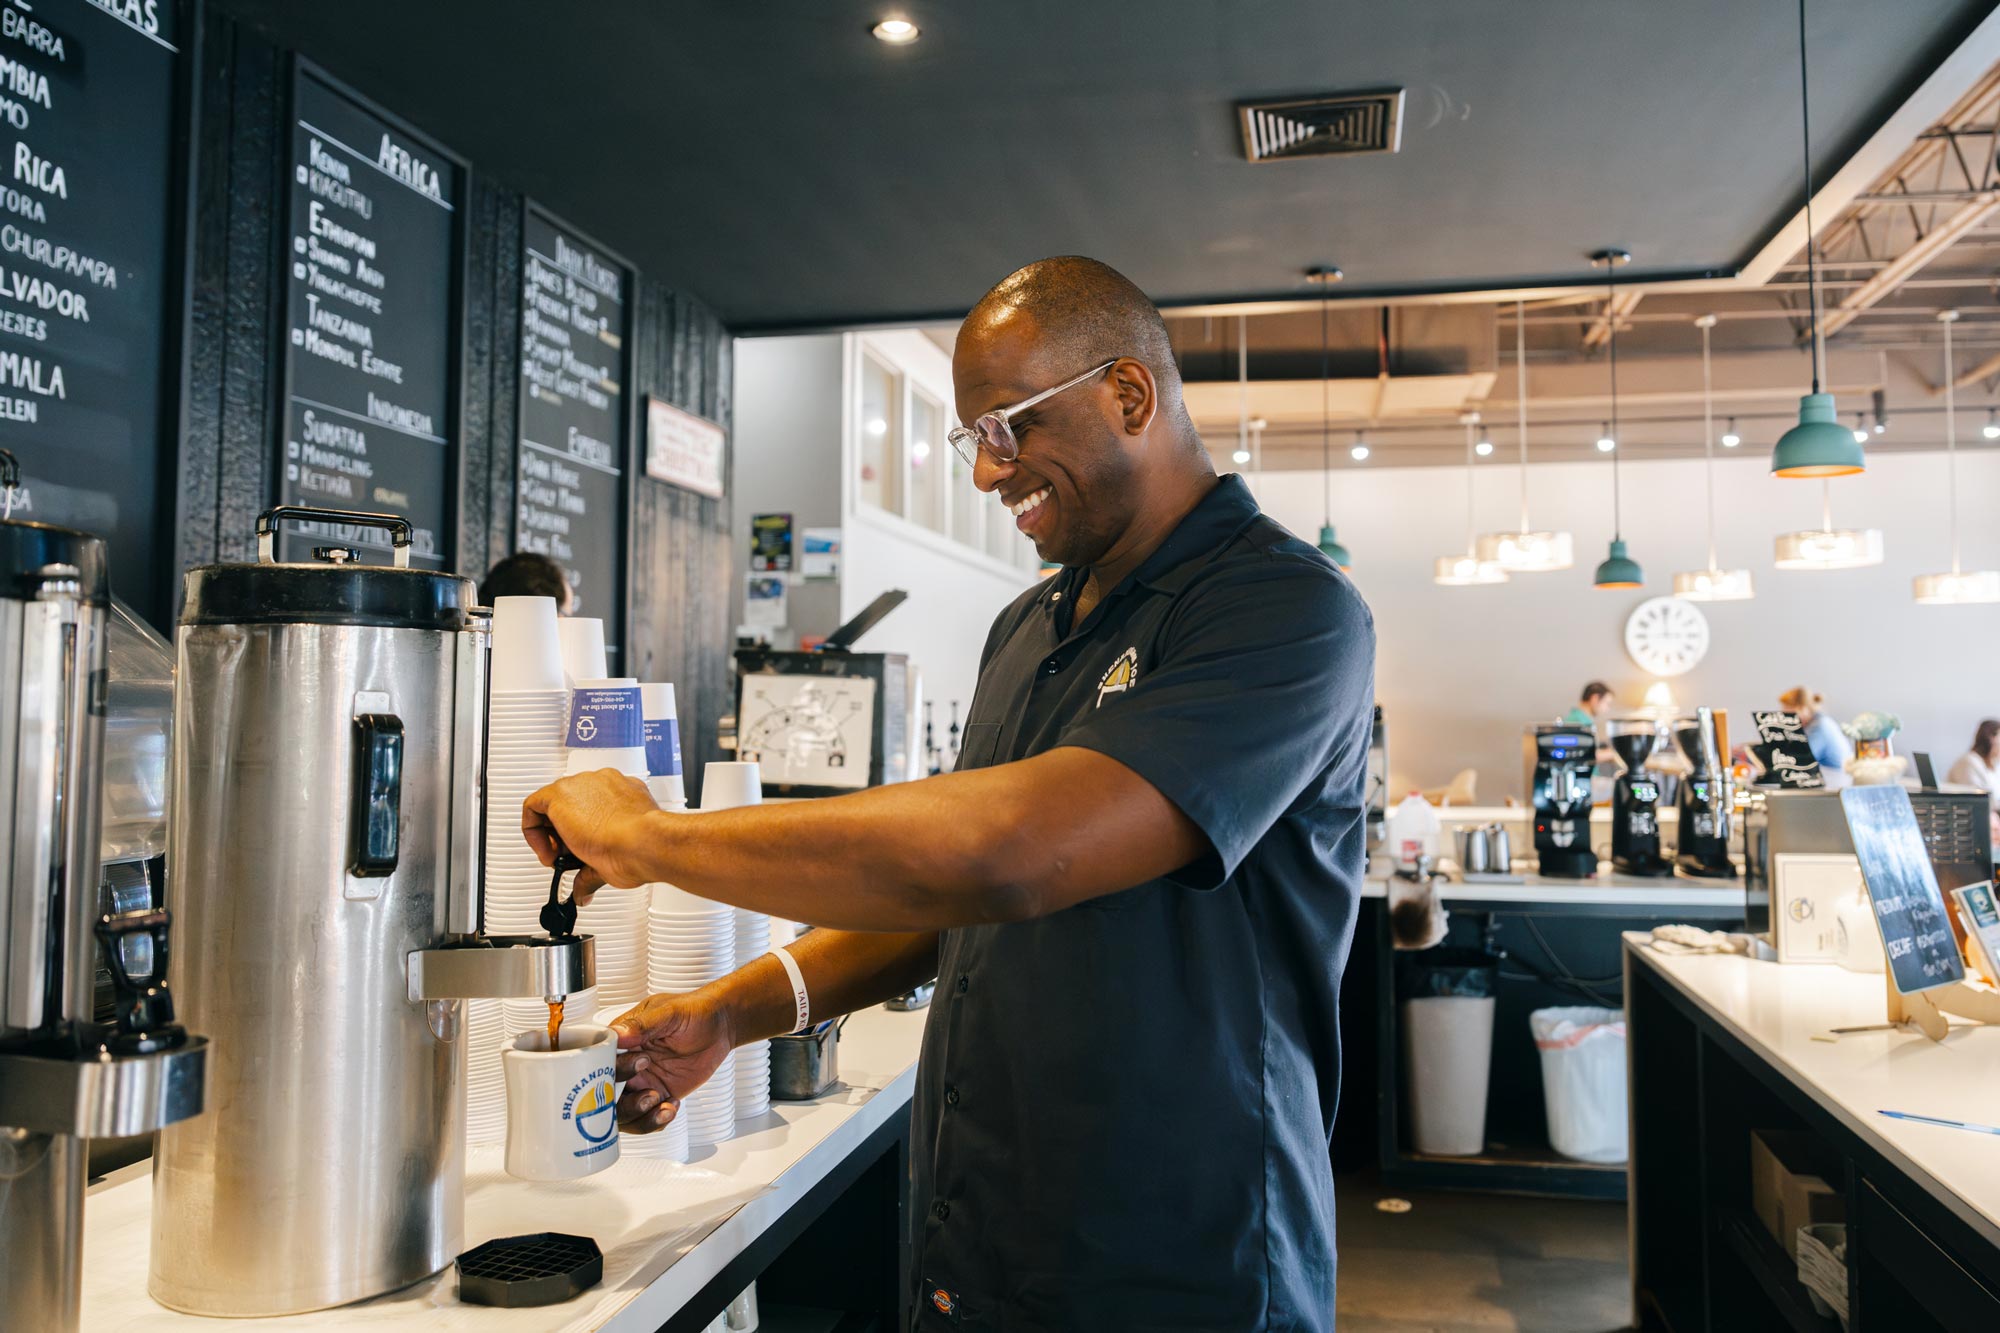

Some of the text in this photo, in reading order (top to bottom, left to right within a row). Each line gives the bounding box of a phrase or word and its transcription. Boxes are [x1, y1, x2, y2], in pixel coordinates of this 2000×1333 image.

[3, 7, 66, 61] BARRA
[14, 141, 67, 200] RICA
[310, 138, 351, 186] KENYA
[378, 133, 441, 199] AFRICA
[305, 293, 373, 349] TANZANIA
[303, 410, 366, 455] SUMATRA
[367, 391, 433, 435] INDONESIA
[601, 703, 618, 711] about
